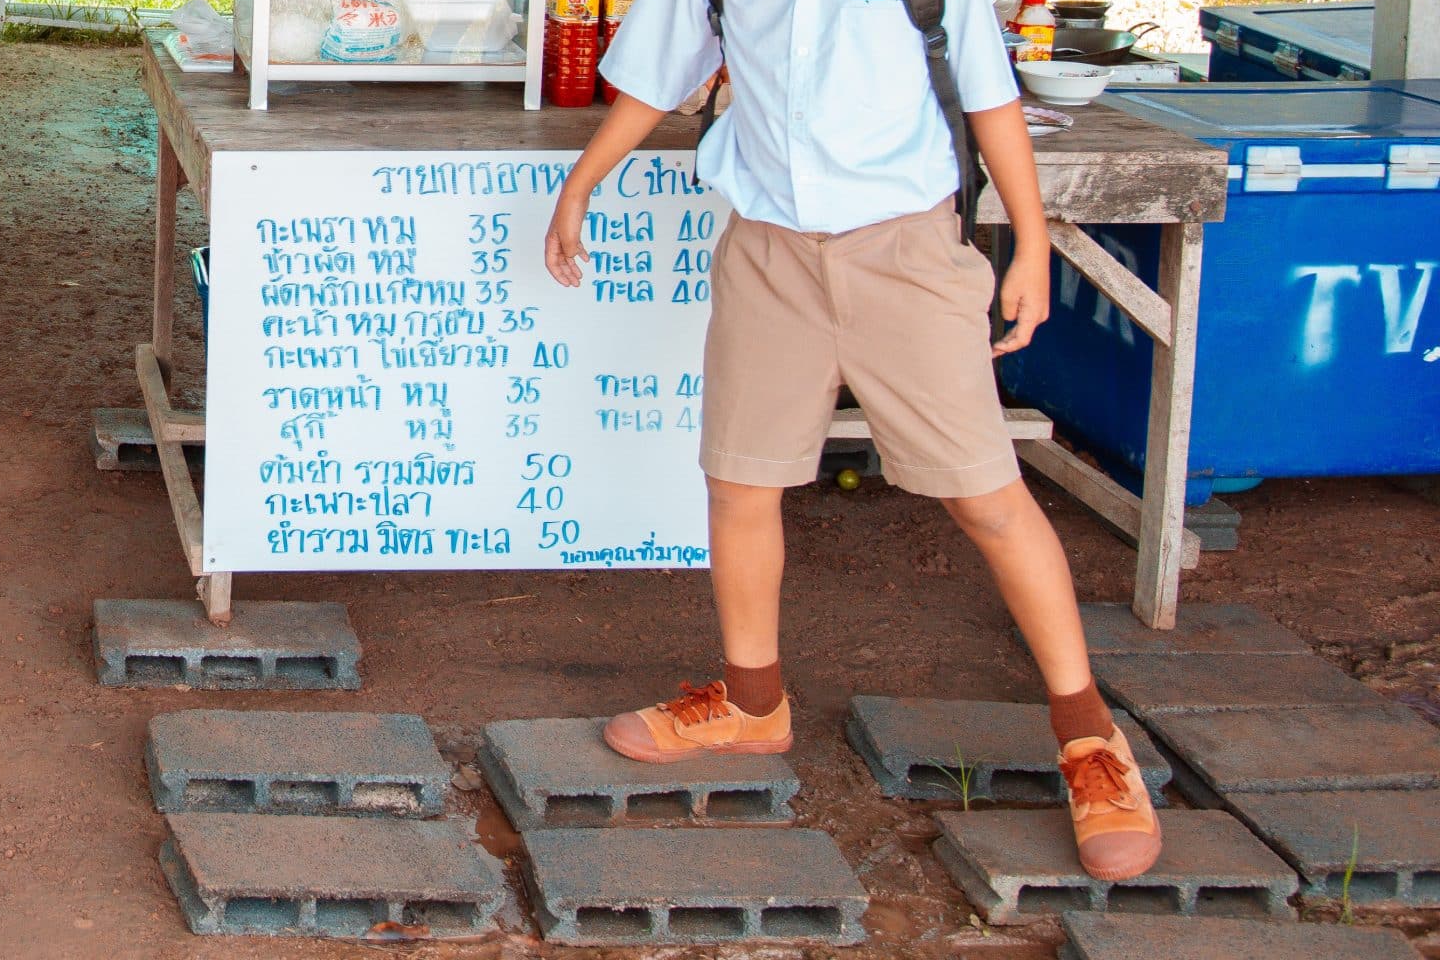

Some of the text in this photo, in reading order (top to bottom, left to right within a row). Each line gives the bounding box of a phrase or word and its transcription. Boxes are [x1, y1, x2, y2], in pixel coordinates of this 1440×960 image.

[372, 160, 602, 197] รายการอาห
[256, 215, 356, 245] กะเพรา
[467, 212, 513, 246] 35
[584, 210, 655, 243] ทะเล
[676, 209, 716, 242] 40
[262, 246, 356, 276] ข้าวผัด
[469, 248, 513, 276] 35
[589, 249, 654, 276] ทะเล
[671, 248, 711, 276] 40
[474, 279, 513, 305] 35
[591, 279, 655, 304] ทะเล
[671, 279, 711, 305] 40
[262, 308, 339, 338] คะน้า
[497, 306, 542, 333] 35
[263, 345, 360, 369] กะเพรา
[532, 341, 570, 369] 40
[261, 374, 382, 411] ราดหน้า
[506, 375, 543, 405] 35
[594, 373, 659, 398] ทะเล
[504, 413, 541, 438] 35
[594, 408, 663, 433] ทะเล
[675, 405, 704, 433] 4
[259, 449, 573, 486] ต้มยำ รวมมิตร 50
[515, 485, 565, 515] 40
[444, 527, 511, 555] ทะเล
[537, 518, 581, 550] 50
